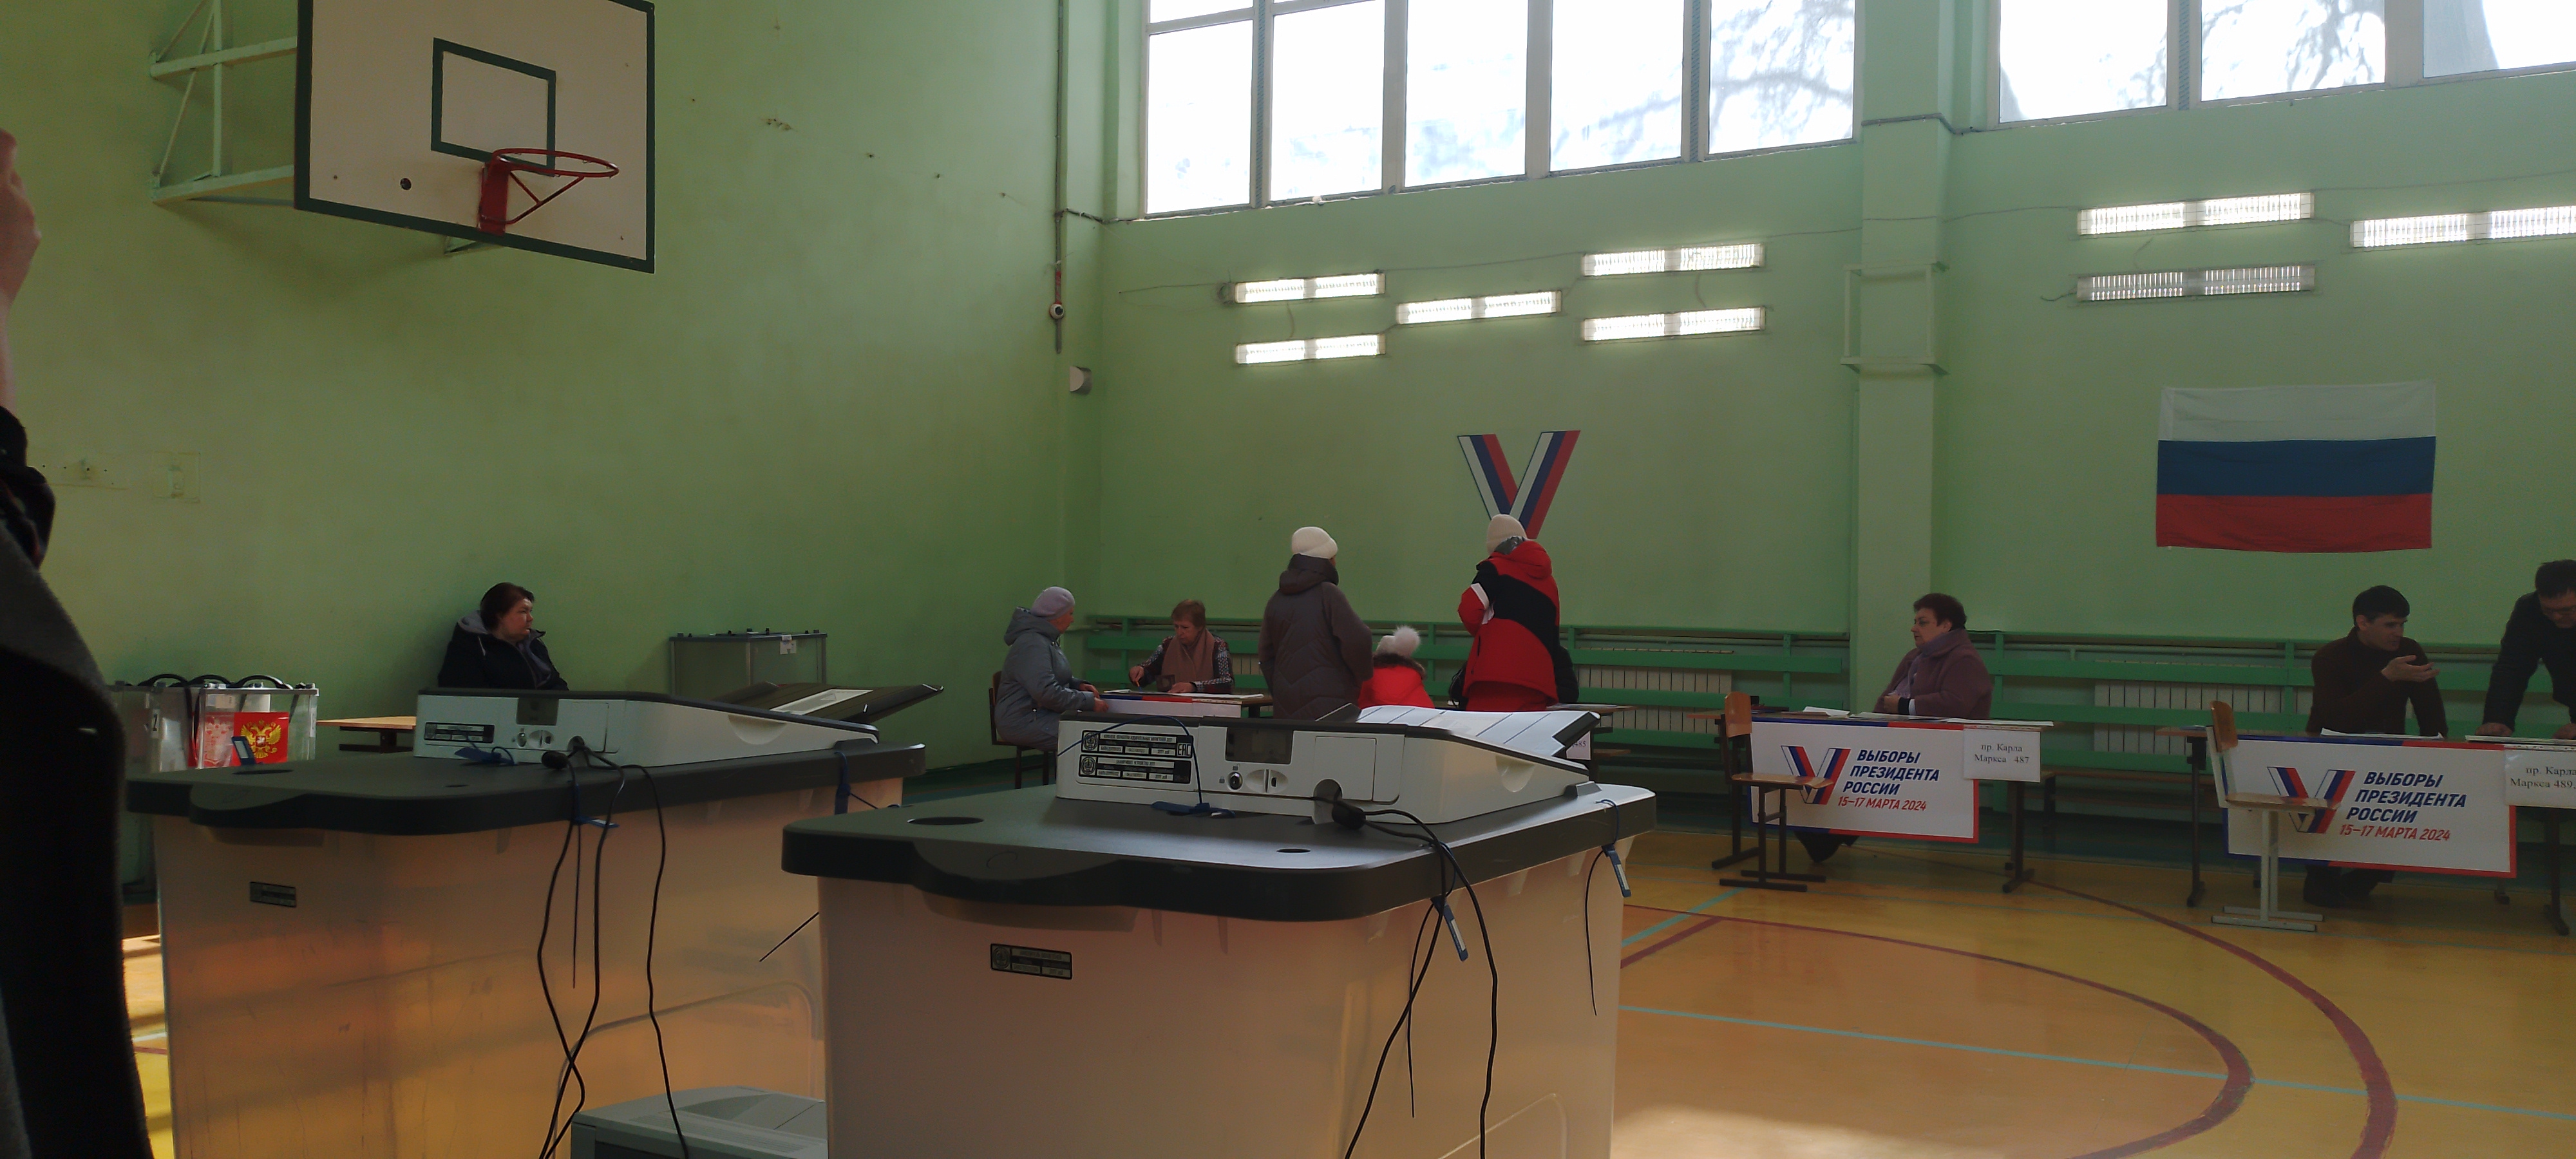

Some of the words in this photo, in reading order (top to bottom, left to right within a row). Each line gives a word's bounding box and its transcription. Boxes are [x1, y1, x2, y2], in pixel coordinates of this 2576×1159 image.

[1996, 743, 2023, 753] Карла
[1856, 749, 1921, 764] ВЫБОРЫ
[1975, 754, 2007, 764] Маркса
[1850, 765, 1940, 782] ПРЕЗИДЕНТА
[2546, 766, 2576, 777] Карла
[2363, 771, 2443, 788] ВЫБОРЫ
[2510, 778, 2550, 789] Маркса
[1842, 780, 1901, 795] РОССИИ
[1866, 797, 1900, 810] МАРТА
[1901, 799, 1927, 811] 2024
[2354, 789, 2467, 807] ПРЕЗИДЕНТА
[2345, 807, 2418, 824] РОССИИ
[2374, 825, 2418, 840] МАРТА
[2419, 828, 2451, 842] 2024
